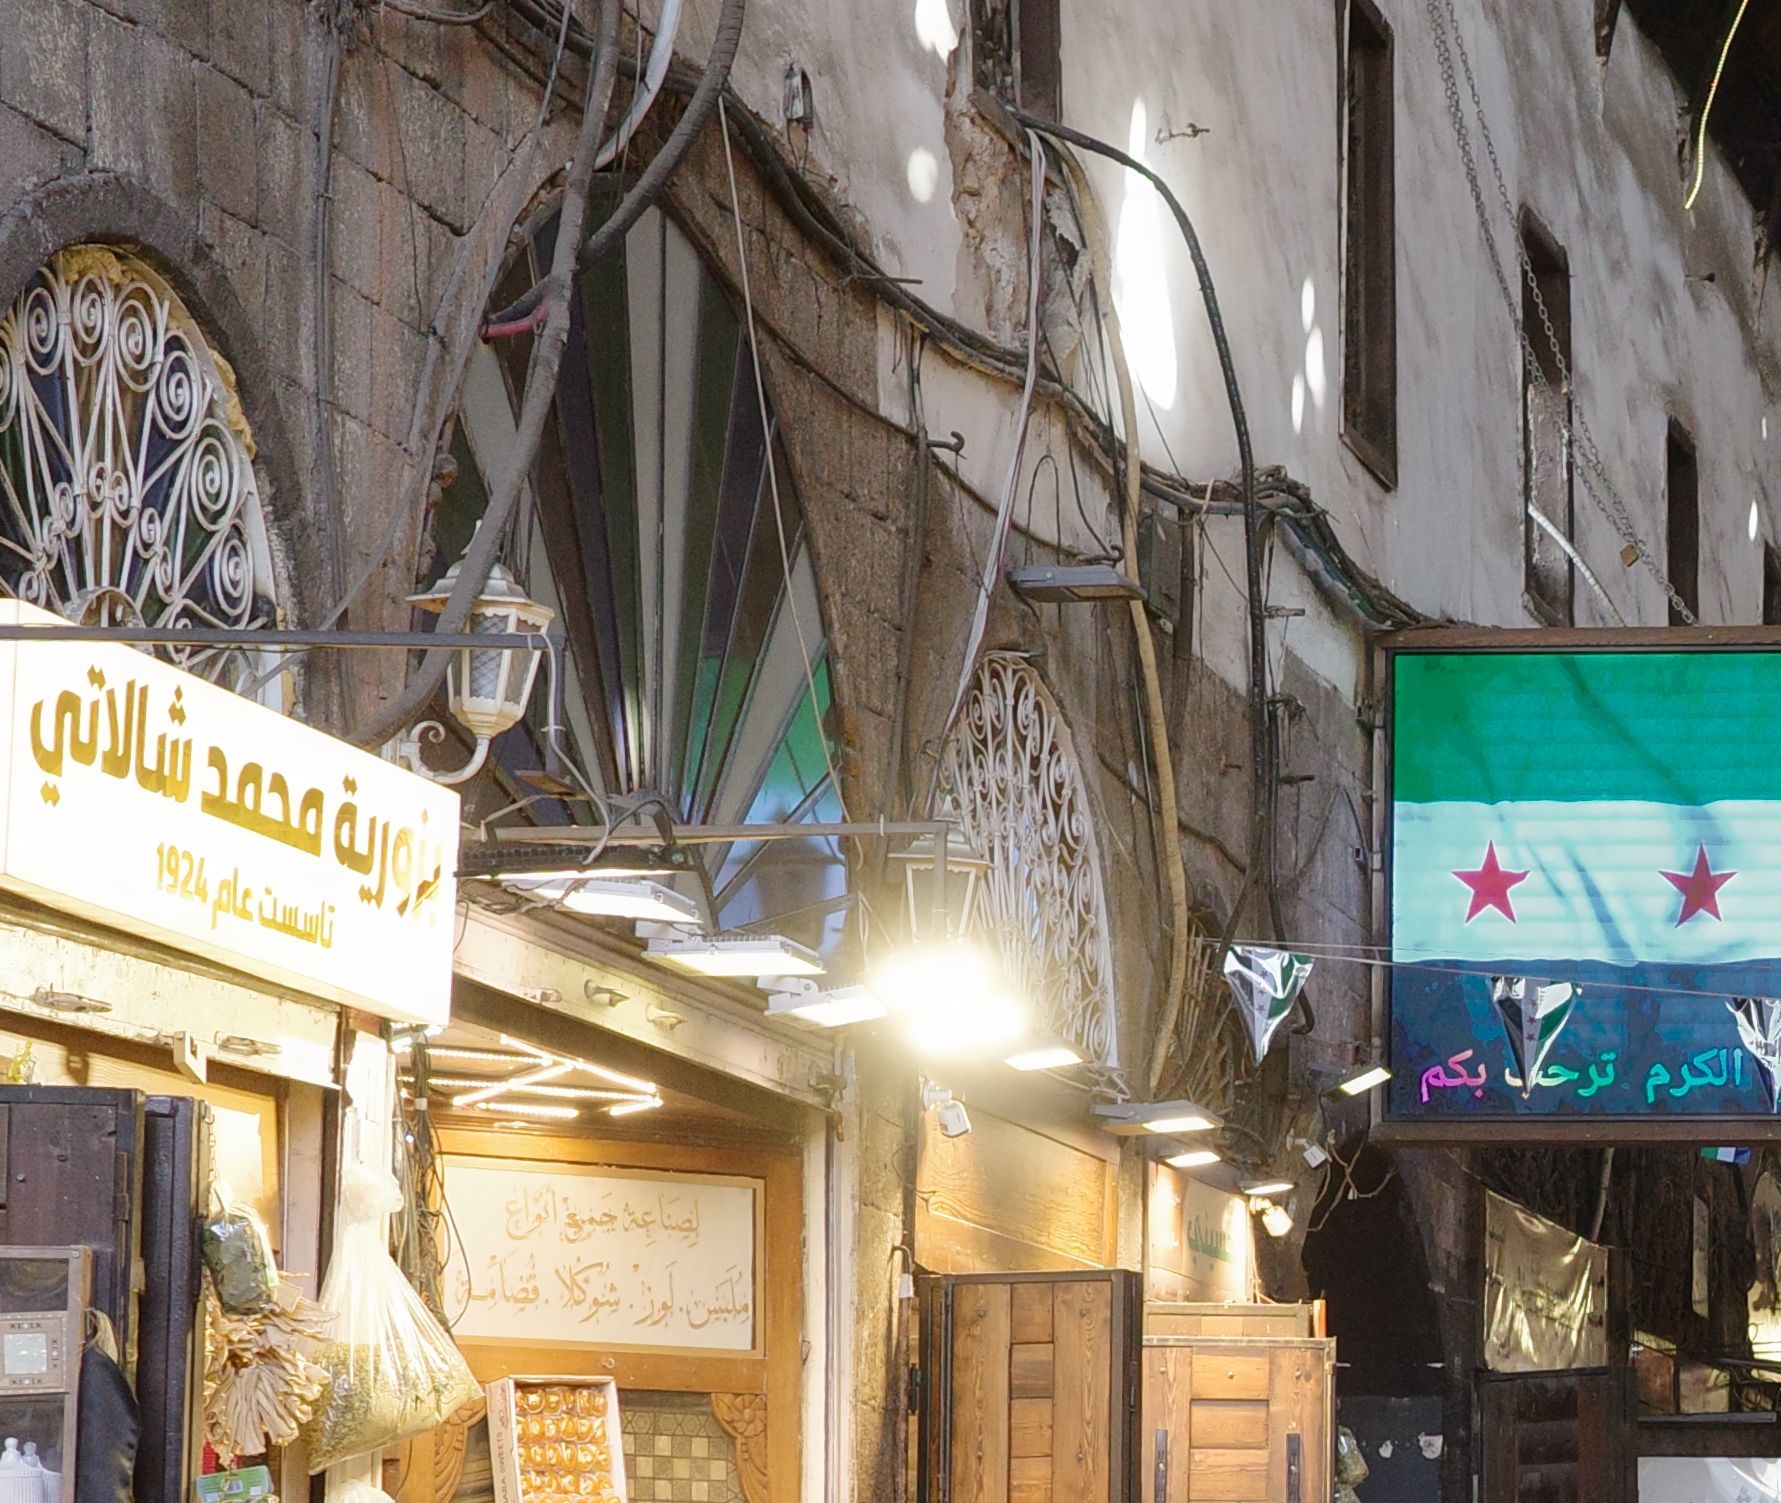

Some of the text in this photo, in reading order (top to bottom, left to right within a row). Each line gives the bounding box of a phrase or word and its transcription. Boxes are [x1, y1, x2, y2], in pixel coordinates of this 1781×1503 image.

[29, 663, 443, 927] بزورية محمد شالاتي
[156, 842, 209, 904] 1924
[211, 867, 255, 930] عام
[1420, 1048, 1488, 1104] بكم
[1646, 1046, 1742, 1103] الكرم
[560, 1192, 617, 1243] جميع
